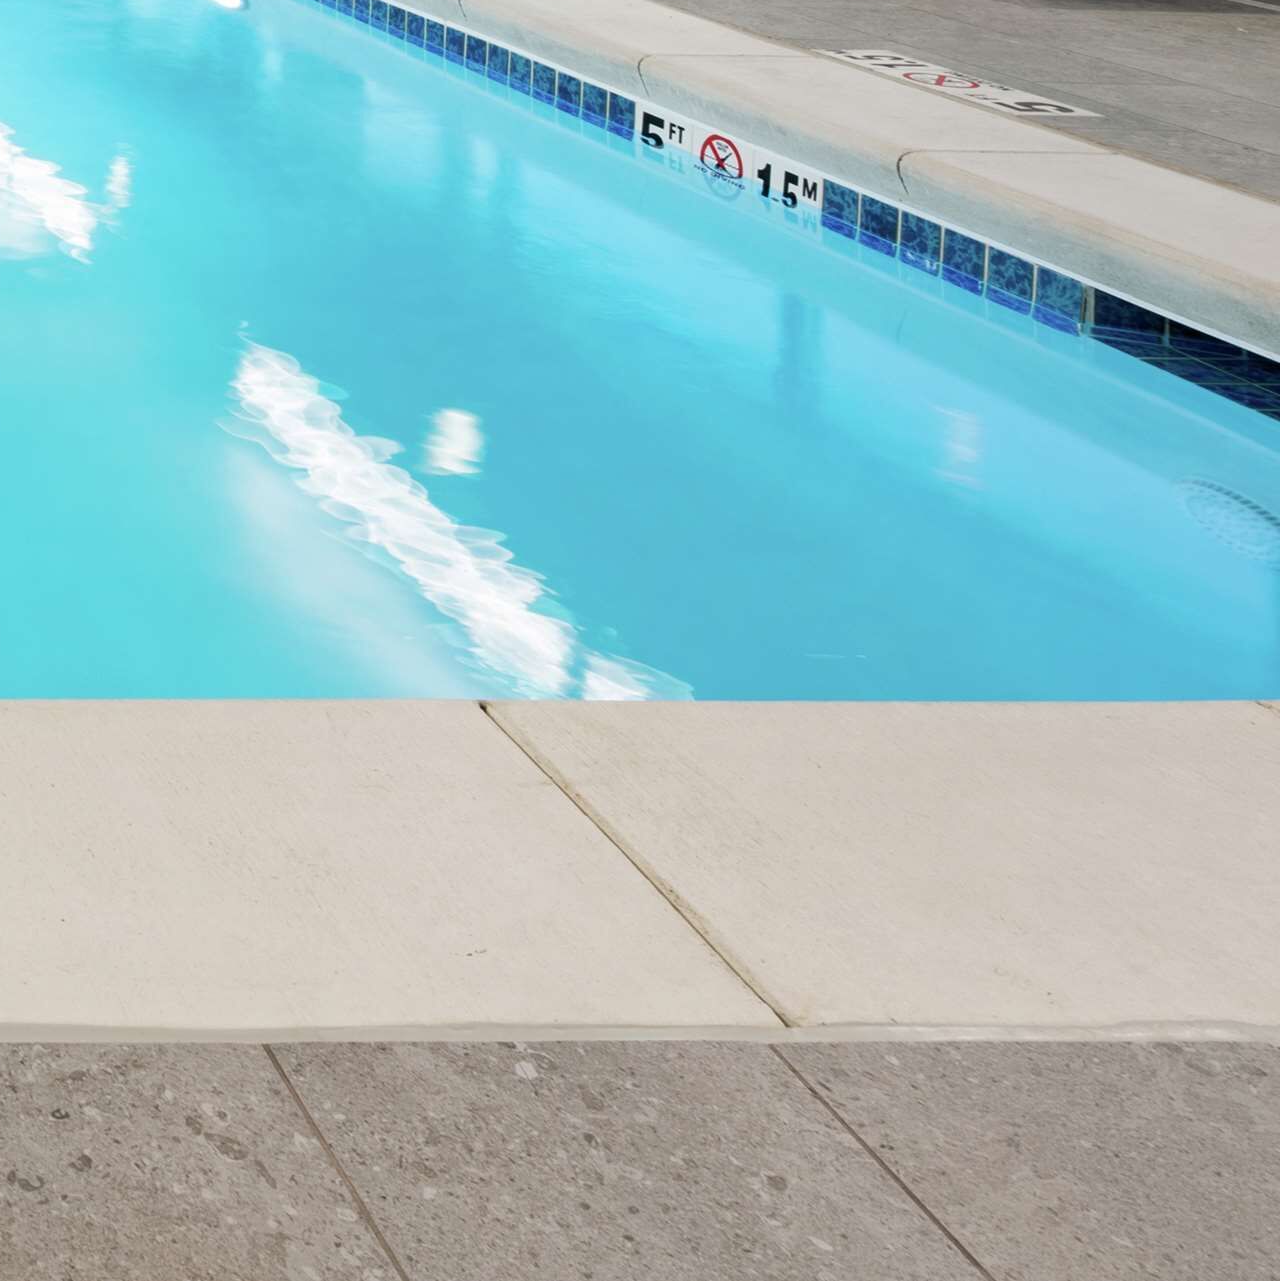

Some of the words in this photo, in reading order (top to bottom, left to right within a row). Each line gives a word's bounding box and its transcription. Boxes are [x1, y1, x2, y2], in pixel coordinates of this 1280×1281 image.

[641, 111, 665, 149] 5
[668, 123, 685, 144] FT
[757, 163, 799, 208] 1.5
[802, 177, 818, 201] M
